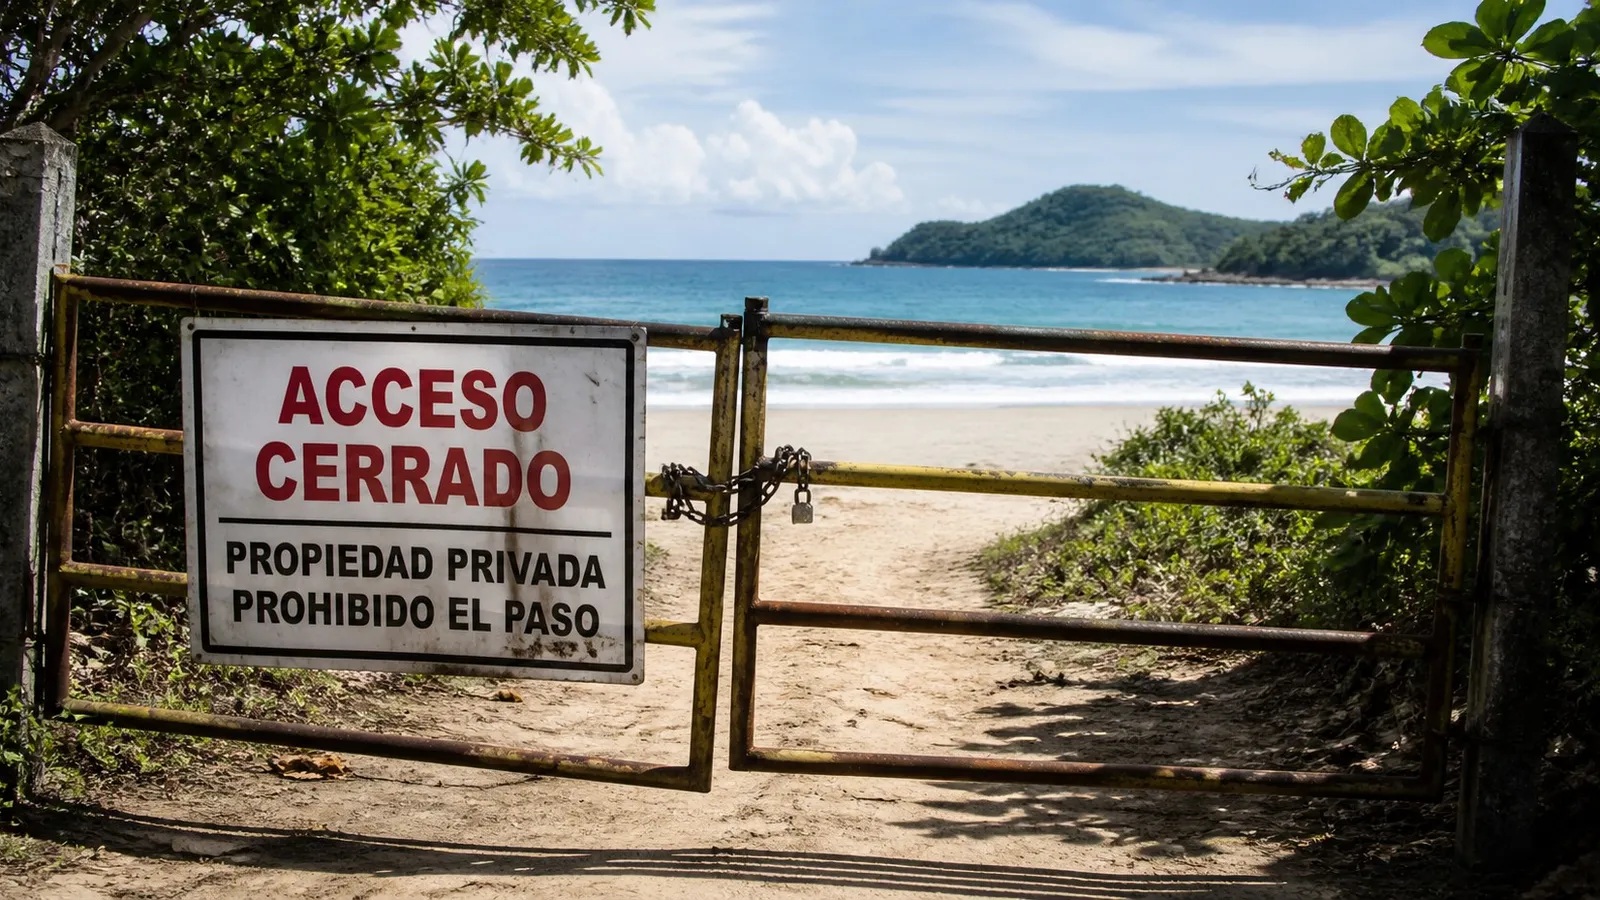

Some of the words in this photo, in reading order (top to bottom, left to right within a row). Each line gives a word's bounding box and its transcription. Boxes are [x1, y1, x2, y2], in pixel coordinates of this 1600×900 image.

[278, 366, 547, 432] ACCESO
[255, 441, 571, 511] CERRADO
[226, 541, 433, 580] PROPIEDAD
[447, 548, 606, 589] PRIVADA
[233, 590, 435, 629] PROHIBIDO
[448, 597, 491, 633] EL
[505, 600, 600, 638] PASO
